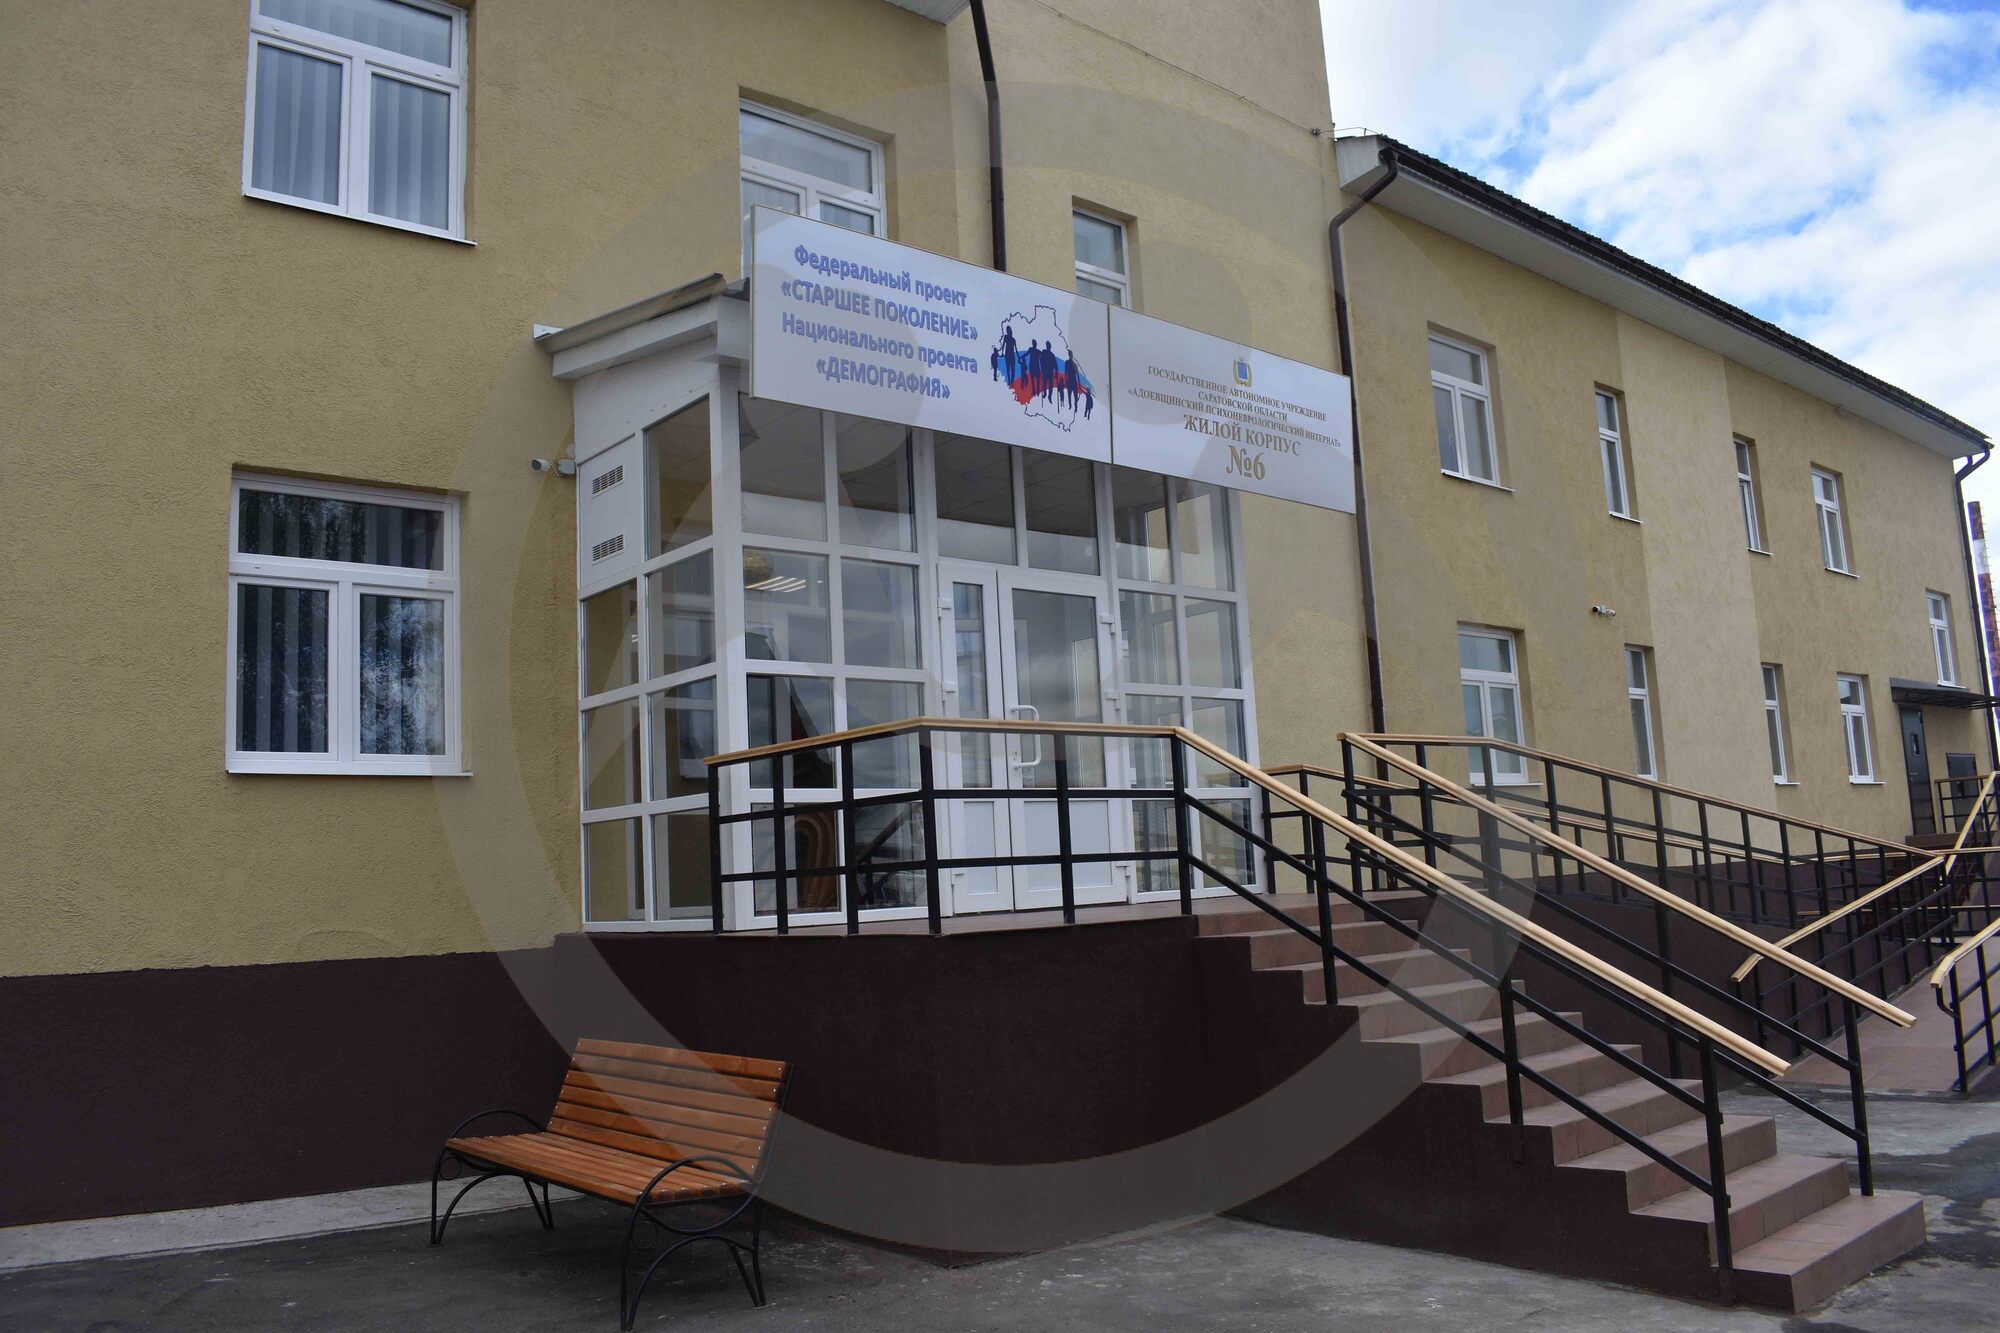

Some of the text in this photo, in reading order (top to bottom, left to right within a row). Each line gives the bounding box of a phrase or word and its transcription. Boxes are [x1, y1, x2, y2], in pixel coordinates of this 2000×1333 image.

[794, 244, 967, 307] Федеральный проект
[781, 279, 978, 341] «СТАРШЕЕ ПОКОЛЕНИЕ»
[782, 312, 978, 374] Национального проекта
[816, 356, 950, 399] «ДЕМОГРАФИЯ»
[1148, 365, 1327, 421] ГОСУДАРСТВЕННОЕ АВТОНОМНОЕ УЧРЕЖДЕНИЕ
[1198, 391, 1288, 422] САРАТОВСКОЙ ОБЛАСТИ
[1205, 404, 1305, 438] ПСИХОНЕВРОЛОГИЧЕСКИЙ
[1305, 430, 1341, 447] ИНТЕРНАТ»
[1183, 414, 1301, 456] ЖИЛОЙ КОРПУС
[1226, 445, 1266, 480] №6
